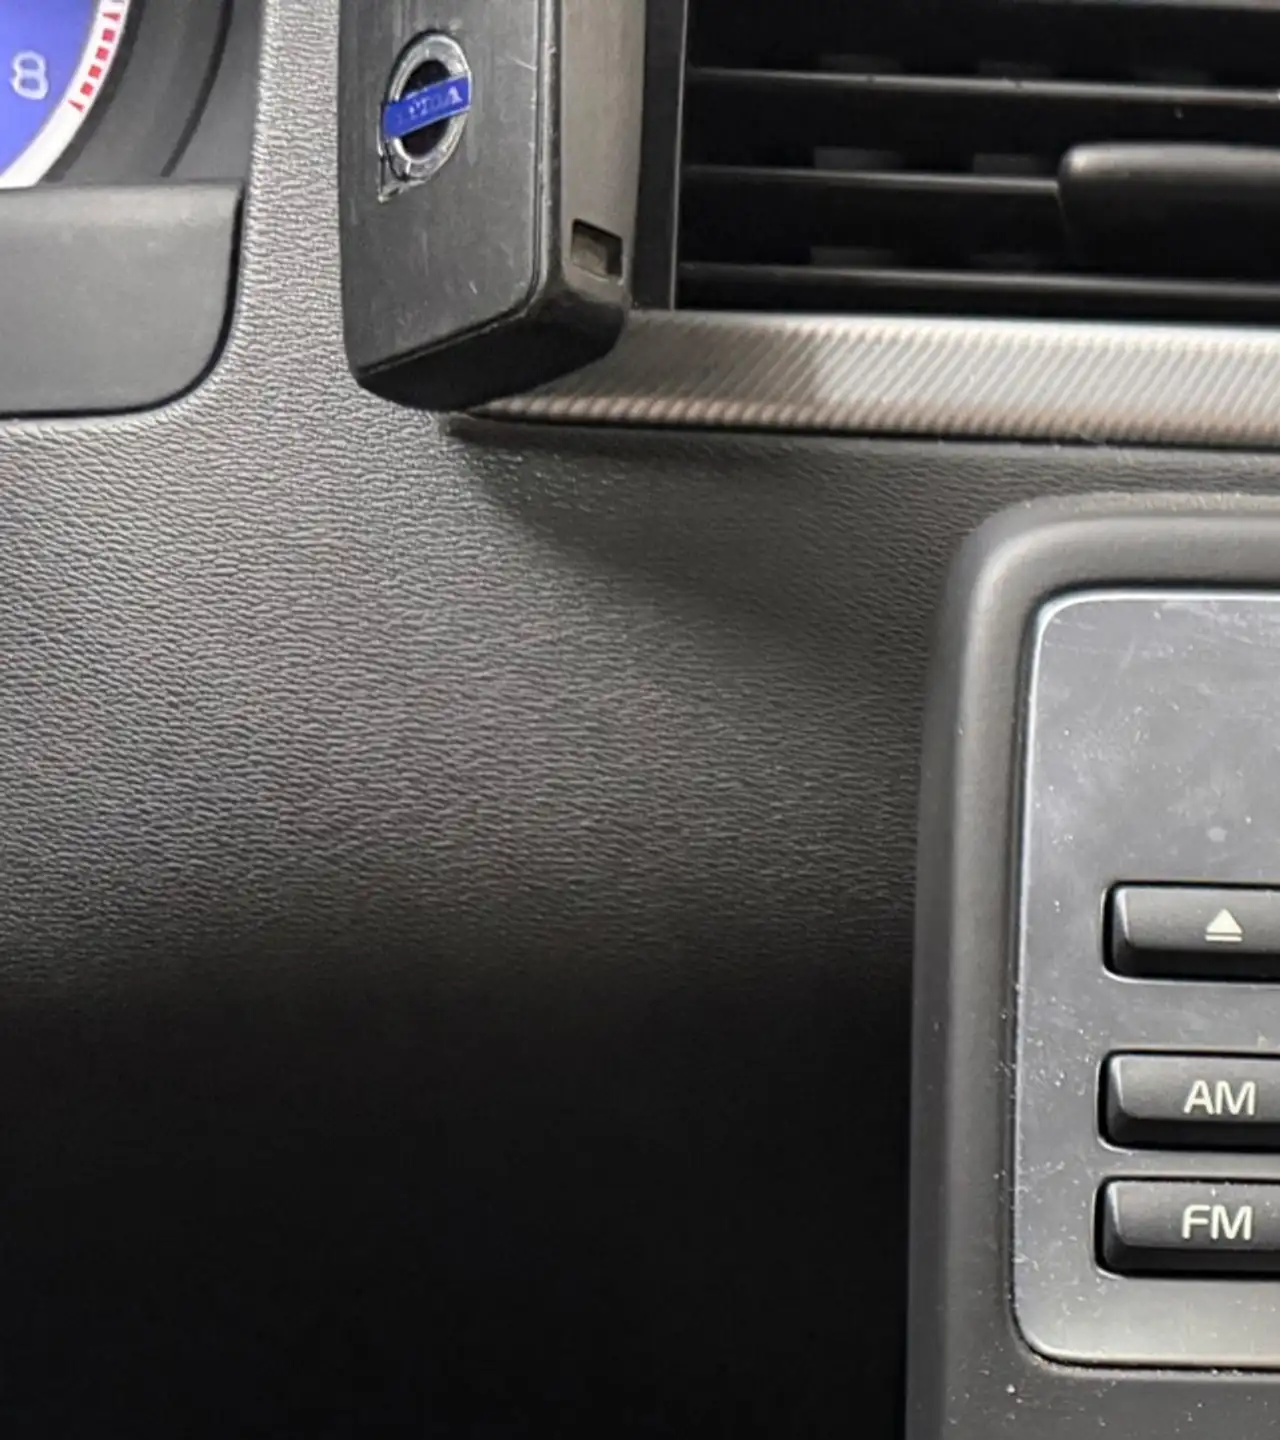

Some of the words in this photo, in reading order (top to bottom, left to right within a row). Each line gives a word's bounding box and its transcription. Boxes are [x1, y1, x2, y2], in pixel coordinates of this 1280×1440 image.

[10, 51, 48, 100] 8
[1181, 1078, 1256, 1116] AM
[1182, 1203, 1253, 1240] FM
